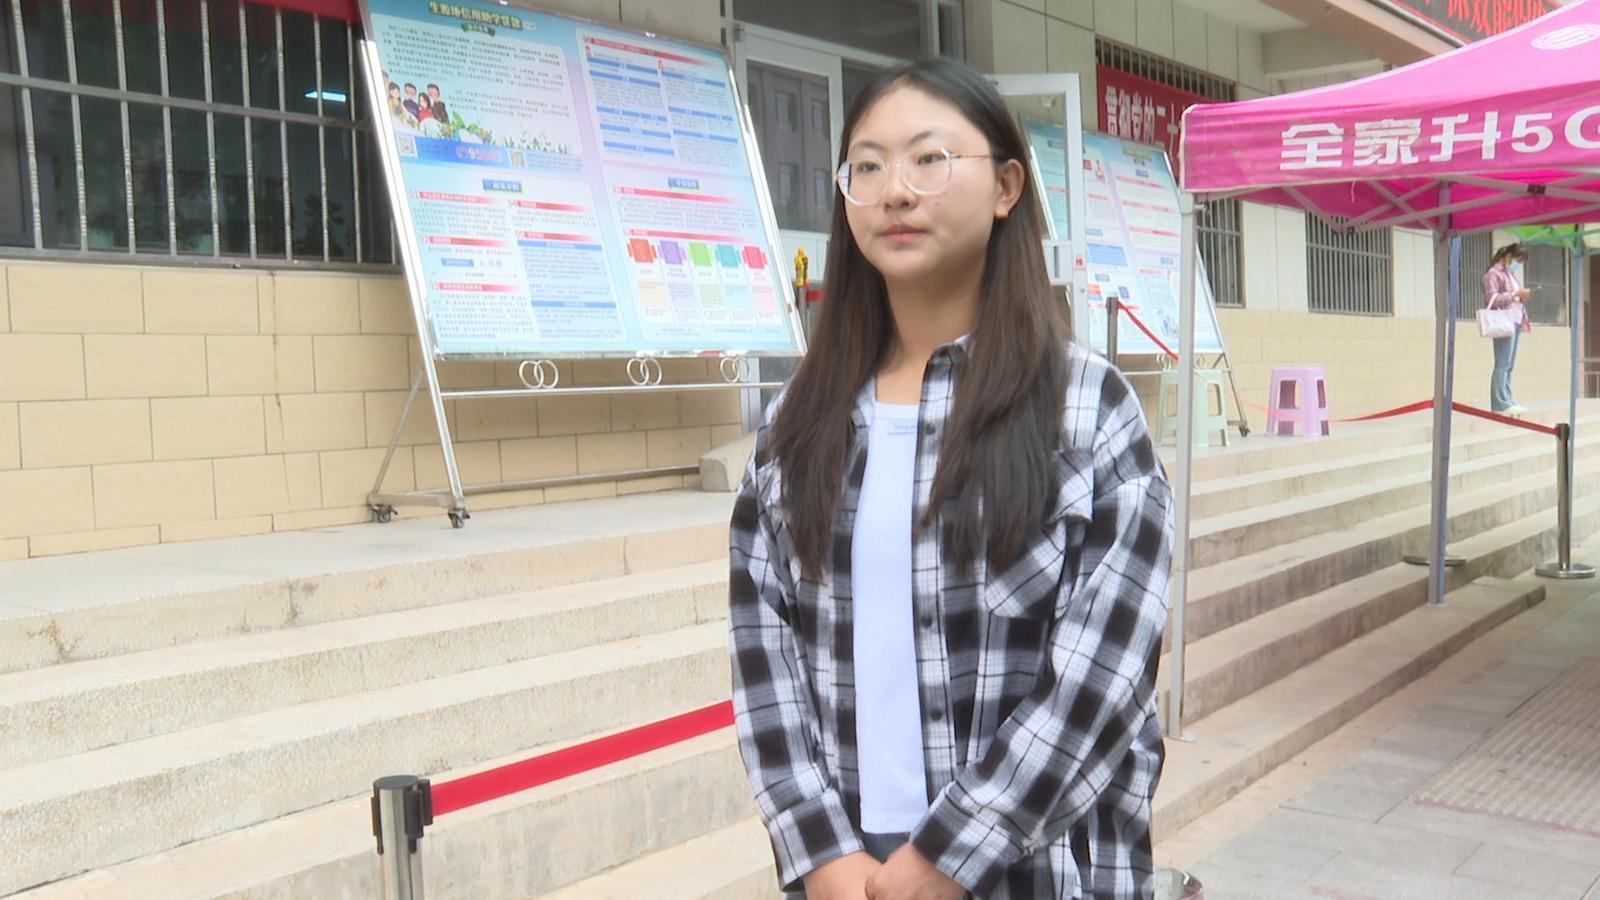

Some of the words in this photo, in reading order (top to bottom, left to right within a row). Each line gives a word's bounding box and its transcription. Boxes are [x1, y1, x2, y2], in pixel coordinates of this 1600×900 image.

[1105, 85, 1184, 157] 贯彻党的二十
